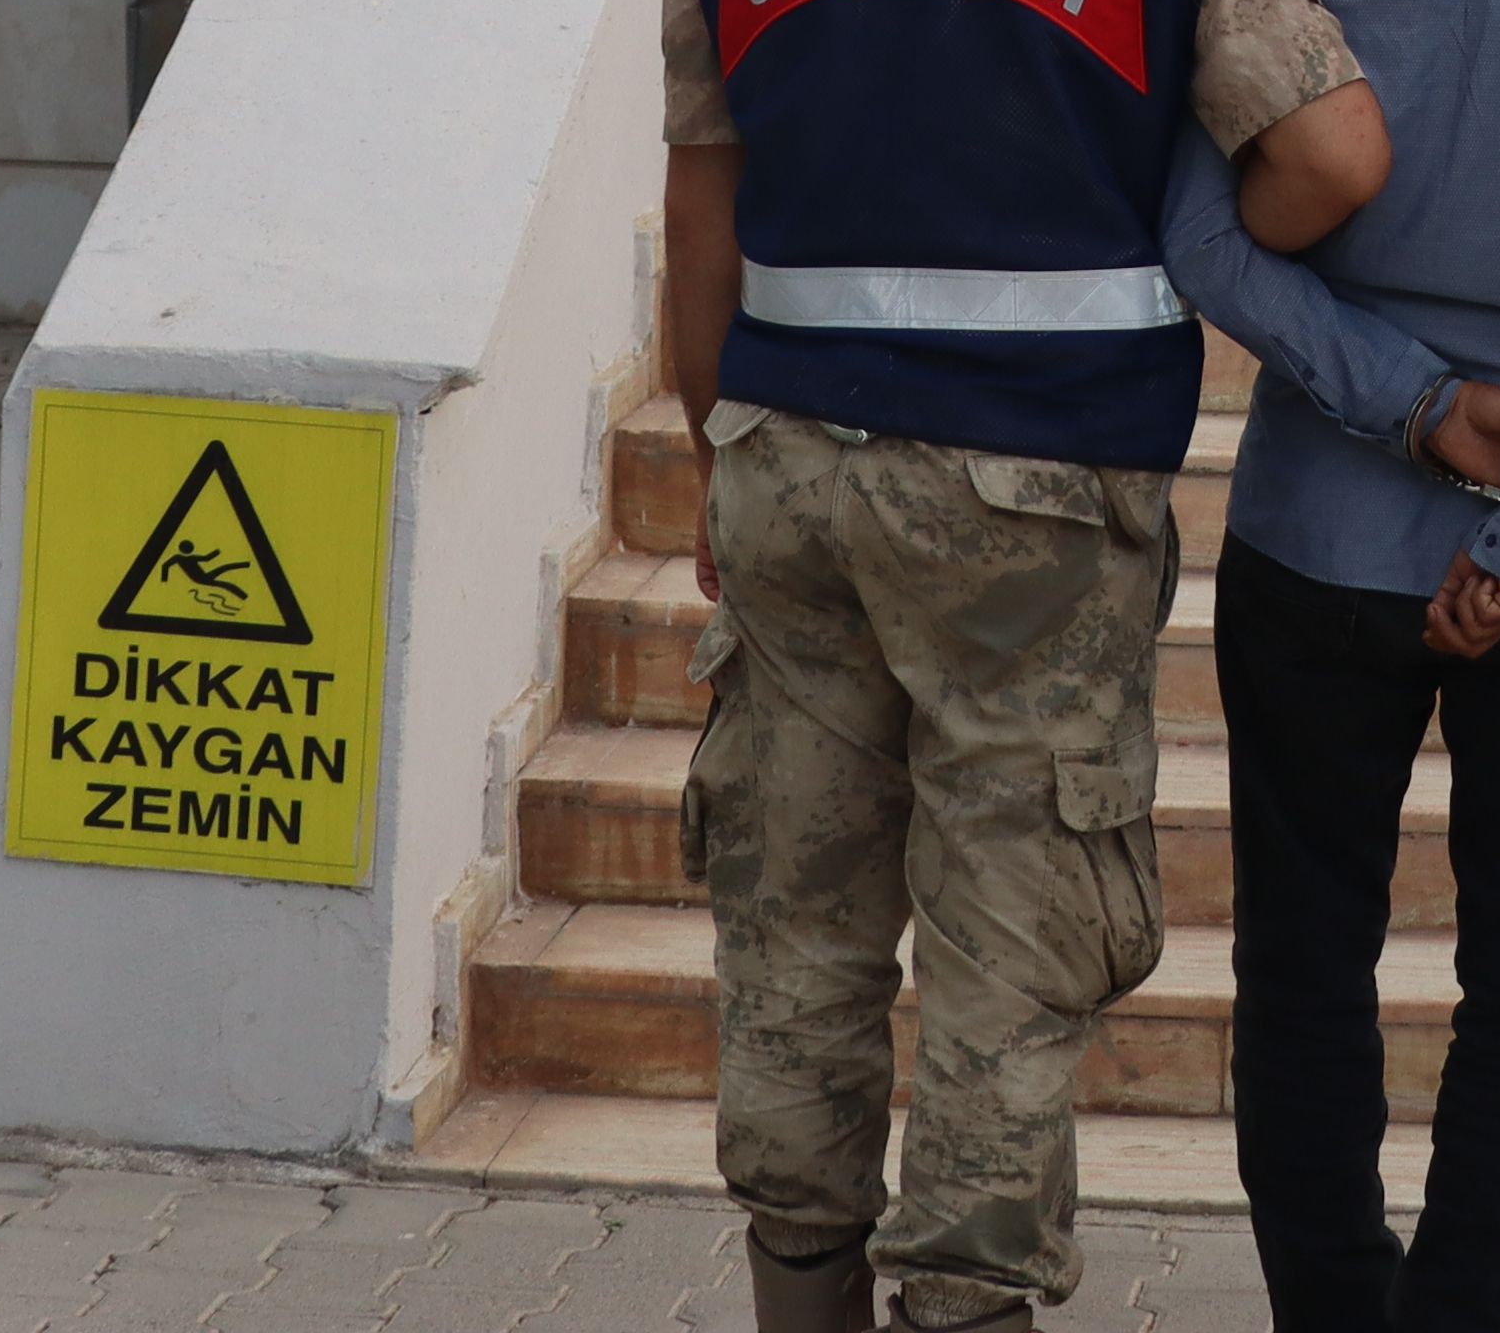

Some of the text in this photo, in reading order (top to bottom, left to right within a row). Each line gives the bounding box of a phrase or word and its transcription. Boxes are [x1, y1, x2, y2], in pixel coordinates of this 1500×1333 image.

[73, 644, 335, 717] DİKKAT
[50, 715, 347, 785] KAYGAN
[83, 783, 303, 846] ZEMİN
